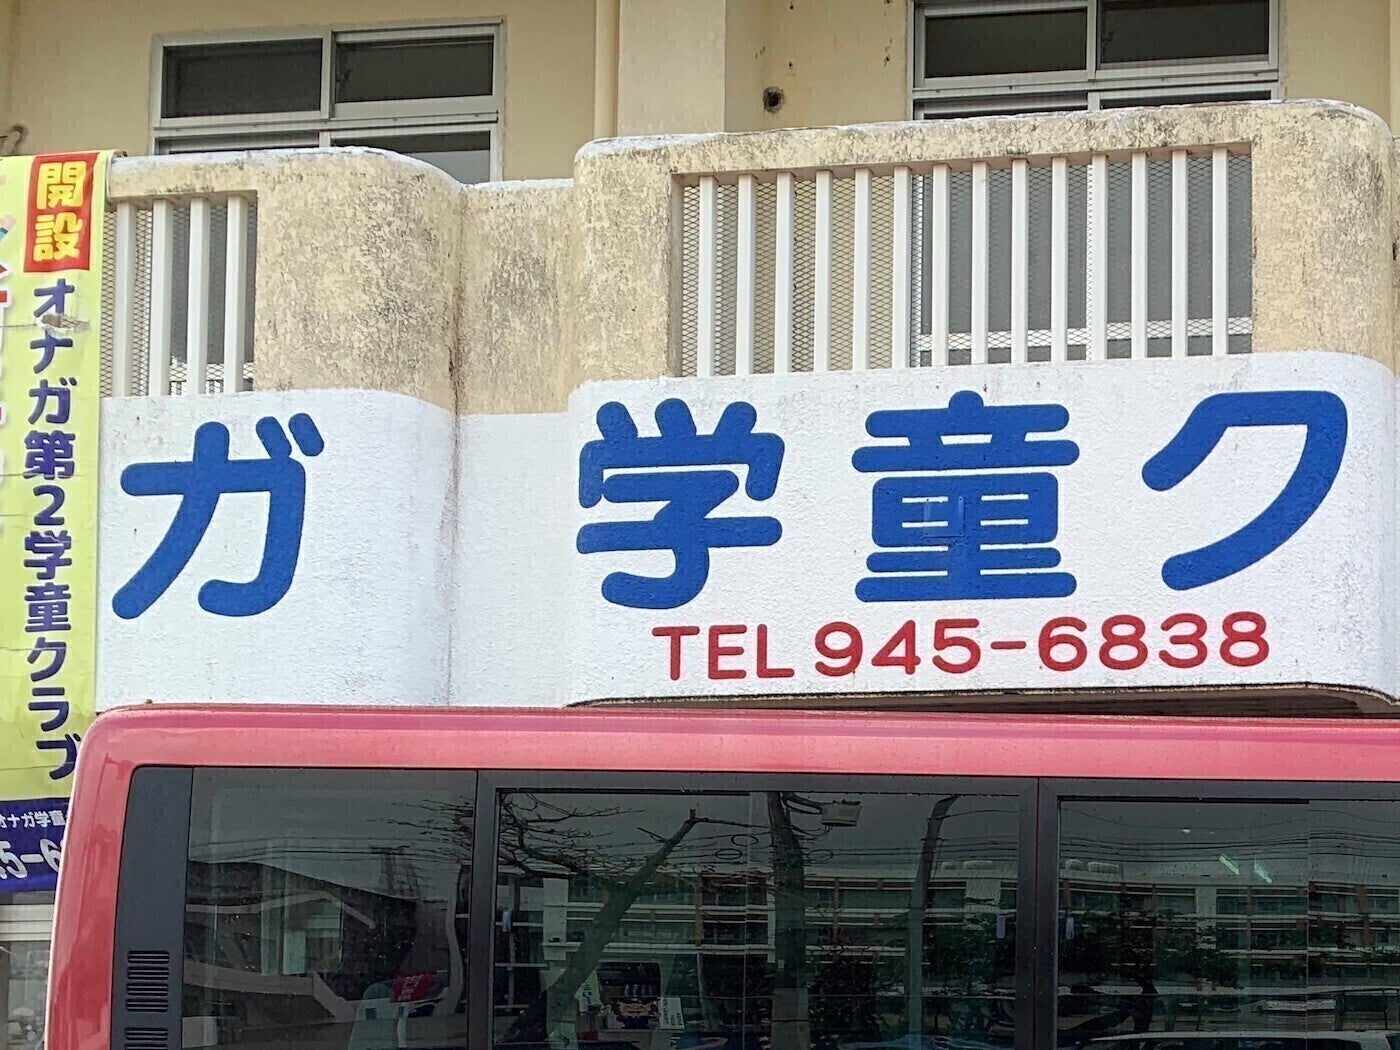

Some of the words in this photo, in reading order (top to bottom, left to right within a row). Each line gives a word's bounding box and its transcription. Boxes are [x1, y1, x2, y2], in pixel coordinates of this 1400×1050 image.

[35, 160, 88, 262] 開設
[23, 277, 81, 780] オナガ第2学童クラブ
[653, 625, 794, 680] TEL
[815, 611, 1269, 677] 945-6838
